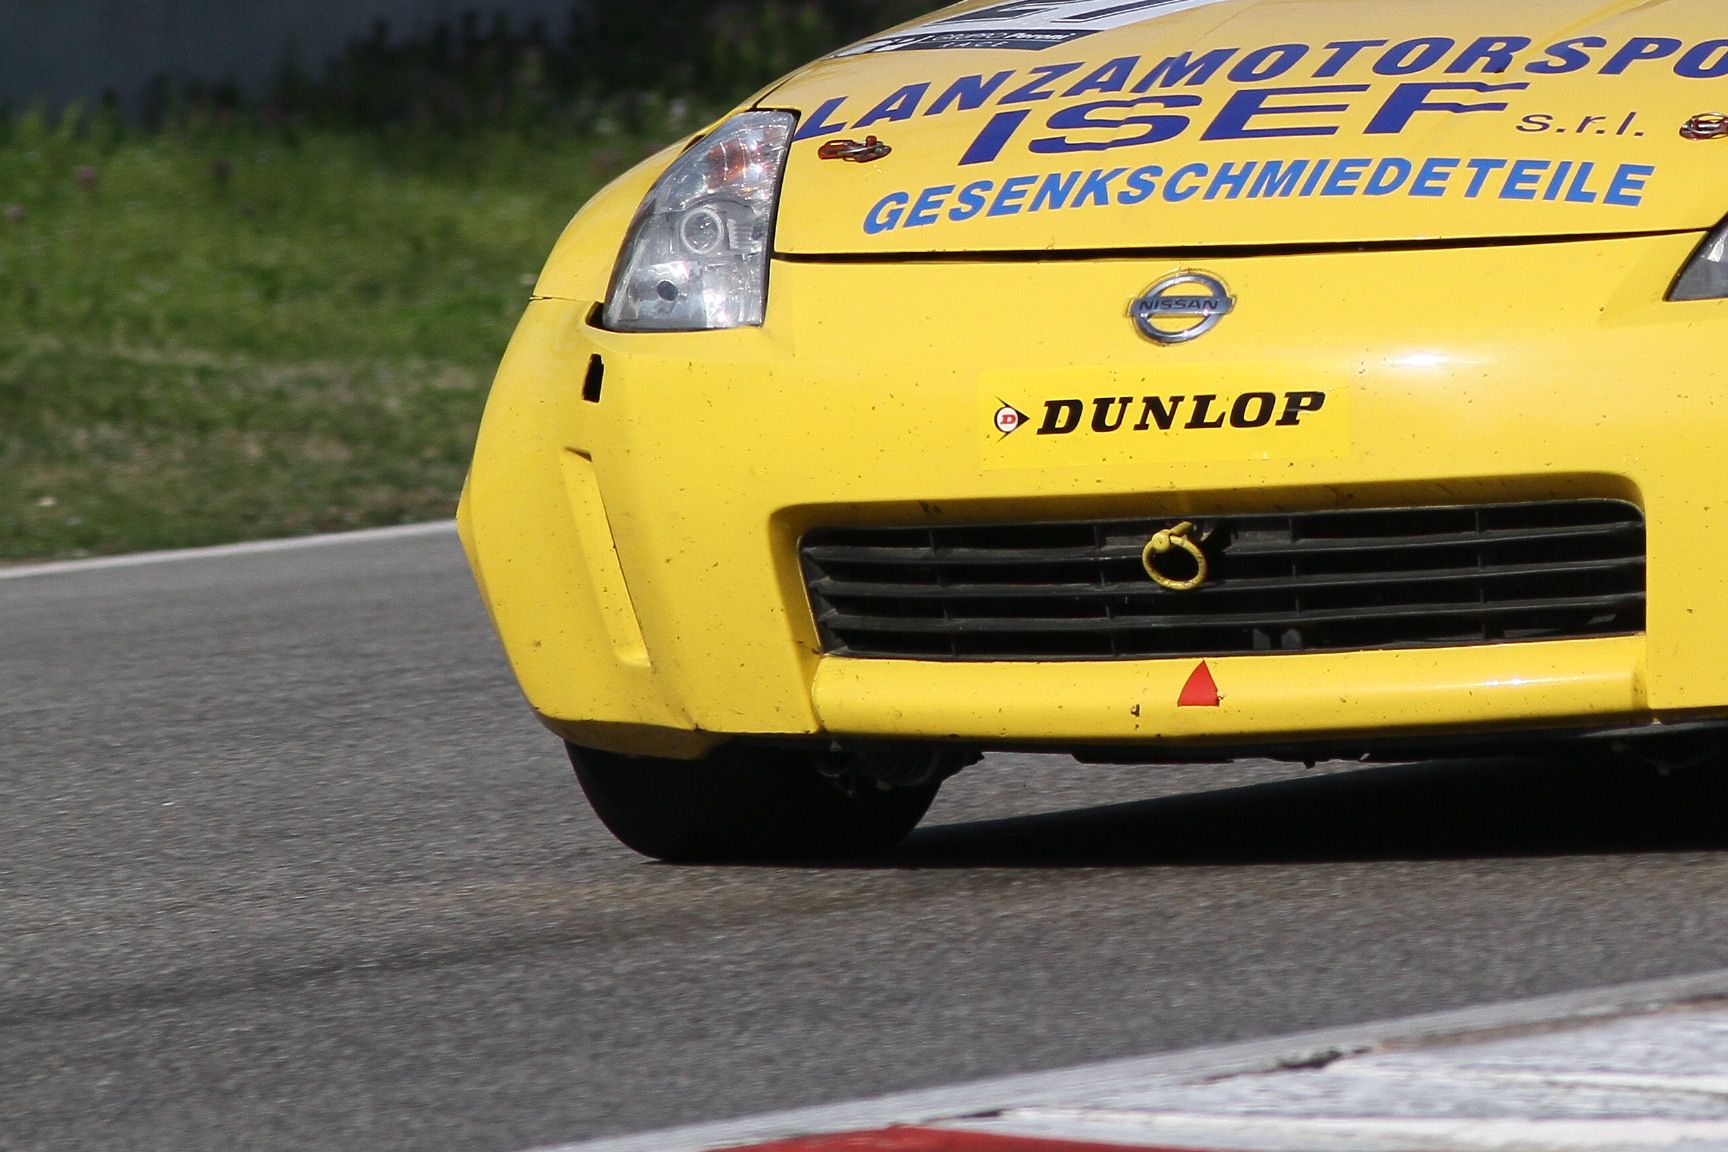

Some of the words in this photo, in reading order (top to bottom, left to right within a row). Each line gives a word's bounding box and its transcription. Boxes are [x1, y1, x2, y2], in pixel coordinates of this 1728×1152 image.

[958, 81, 1530, 165] ISEF
[1516, 111, 1645, 137] s.r.l.
[863, 157, 1654, 235] GESENKSCHMIEDETEILE
[1139, 299, 1219, 310] NISSAN
[1036, 391, 1326, 435] DUNLOP
